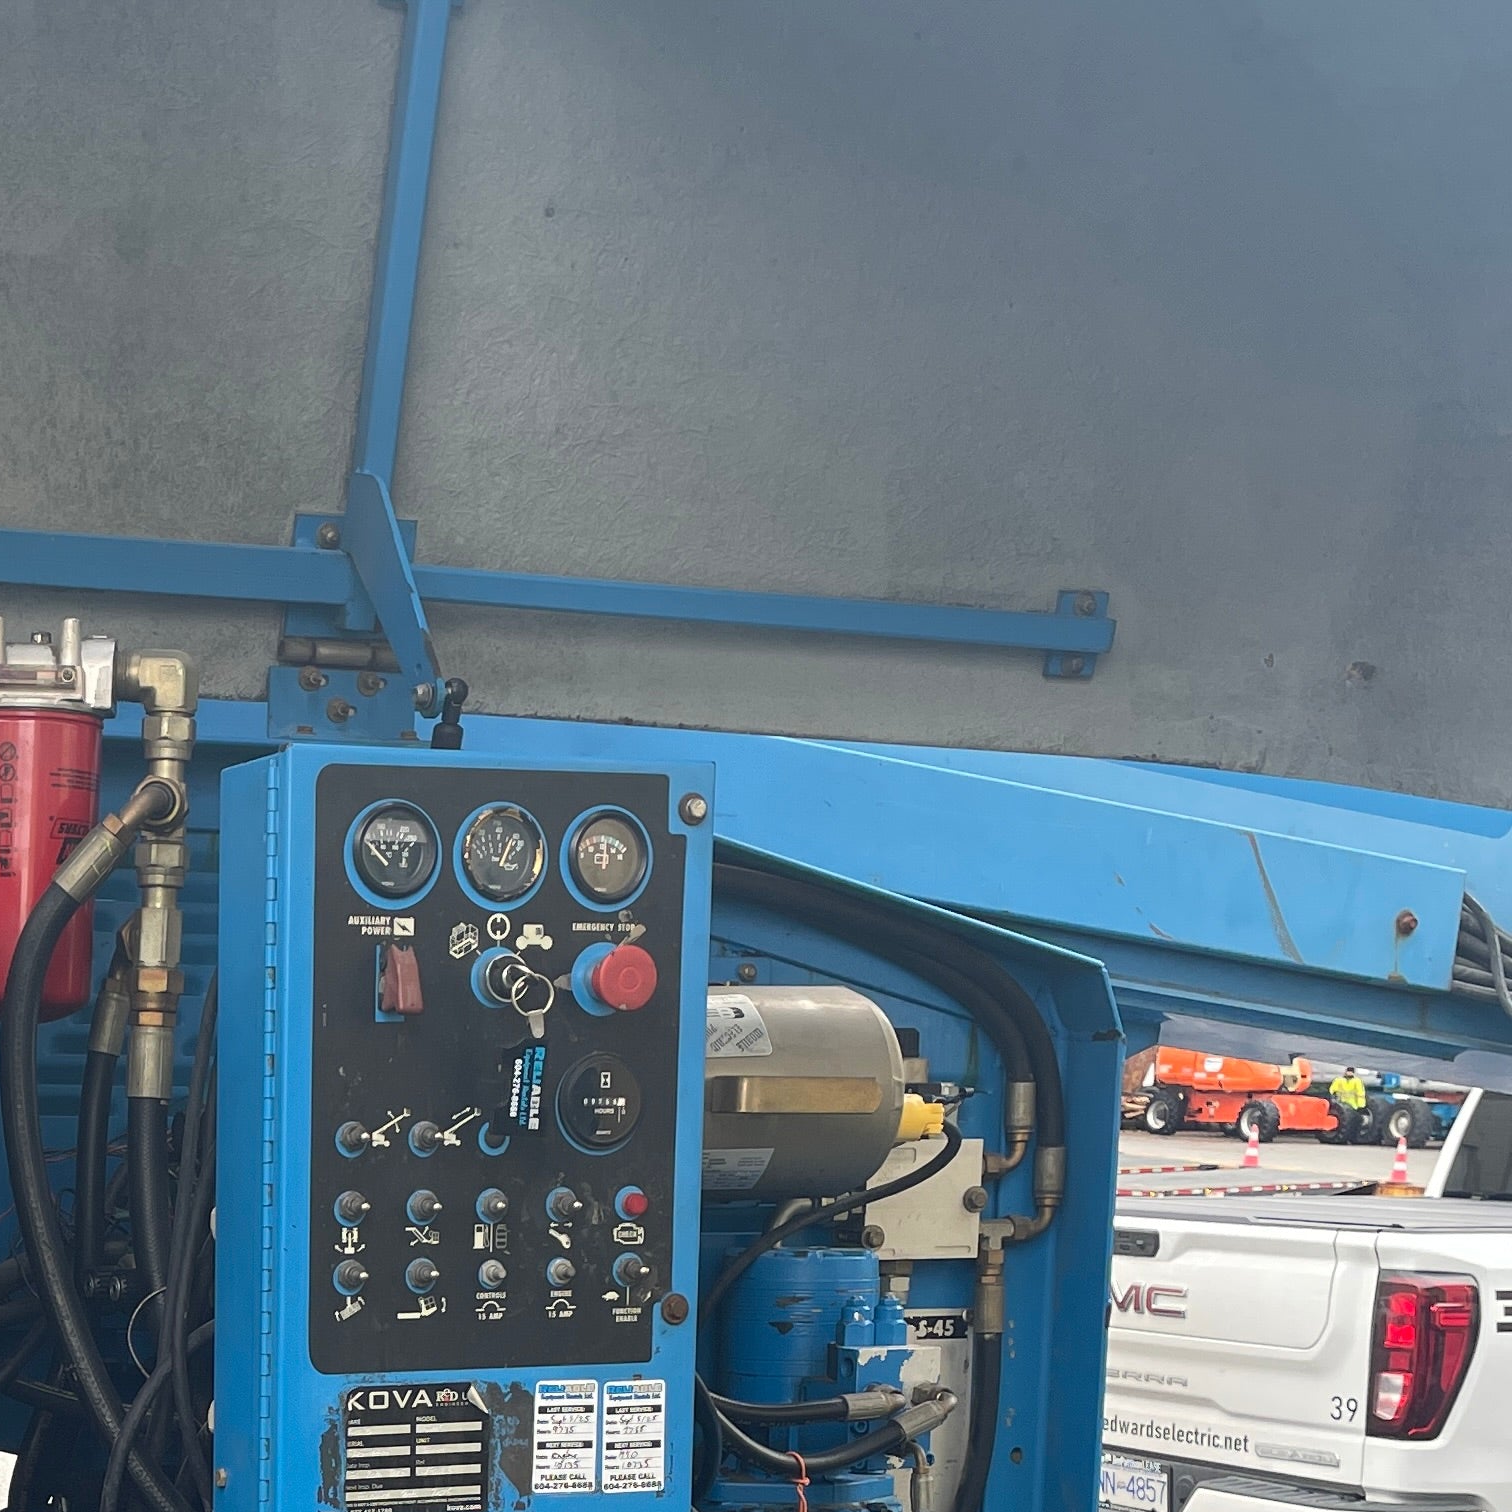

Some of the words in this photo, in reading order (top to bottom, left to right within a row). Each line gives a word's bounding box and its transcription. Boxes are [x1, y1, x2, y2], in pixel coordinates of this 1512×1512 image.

[347, 915, 392, 926] AUXILIARY
[361, 926, 393, 936] POWER
[572, 922, 615, 932] EMERGENCY
[617, 923, 636, 932] STOP
[476, 1291, 507, 1300] CONTROLS
[550, 1289, 573, 1298] ENGINE
[1109, 1279, 1189, 1319] MC
[478, 1313, 487, 1321] 15
[489, 1312, 504, 1320] AMP
[548, 1310, 557, 1319] 15
[558, 1310, 574, 1318] AMP
[612, 1307, 642, 1316] FUNCTION
[916, 1319, 955, 1338] S-45
[1106, 1367, 1189, 1387] ERRA
[347, 1389, 433, 1412] KOVA
[1330, 1395, 1359, 1423] 39
[1103, 1414, 1250, 1453] edwardselectric.net
[540, 1473, 568, 1481] PLEASE
[609, 1473, 637, 1481] PLEASE
[637, 1472, 656, 1480] CALL
